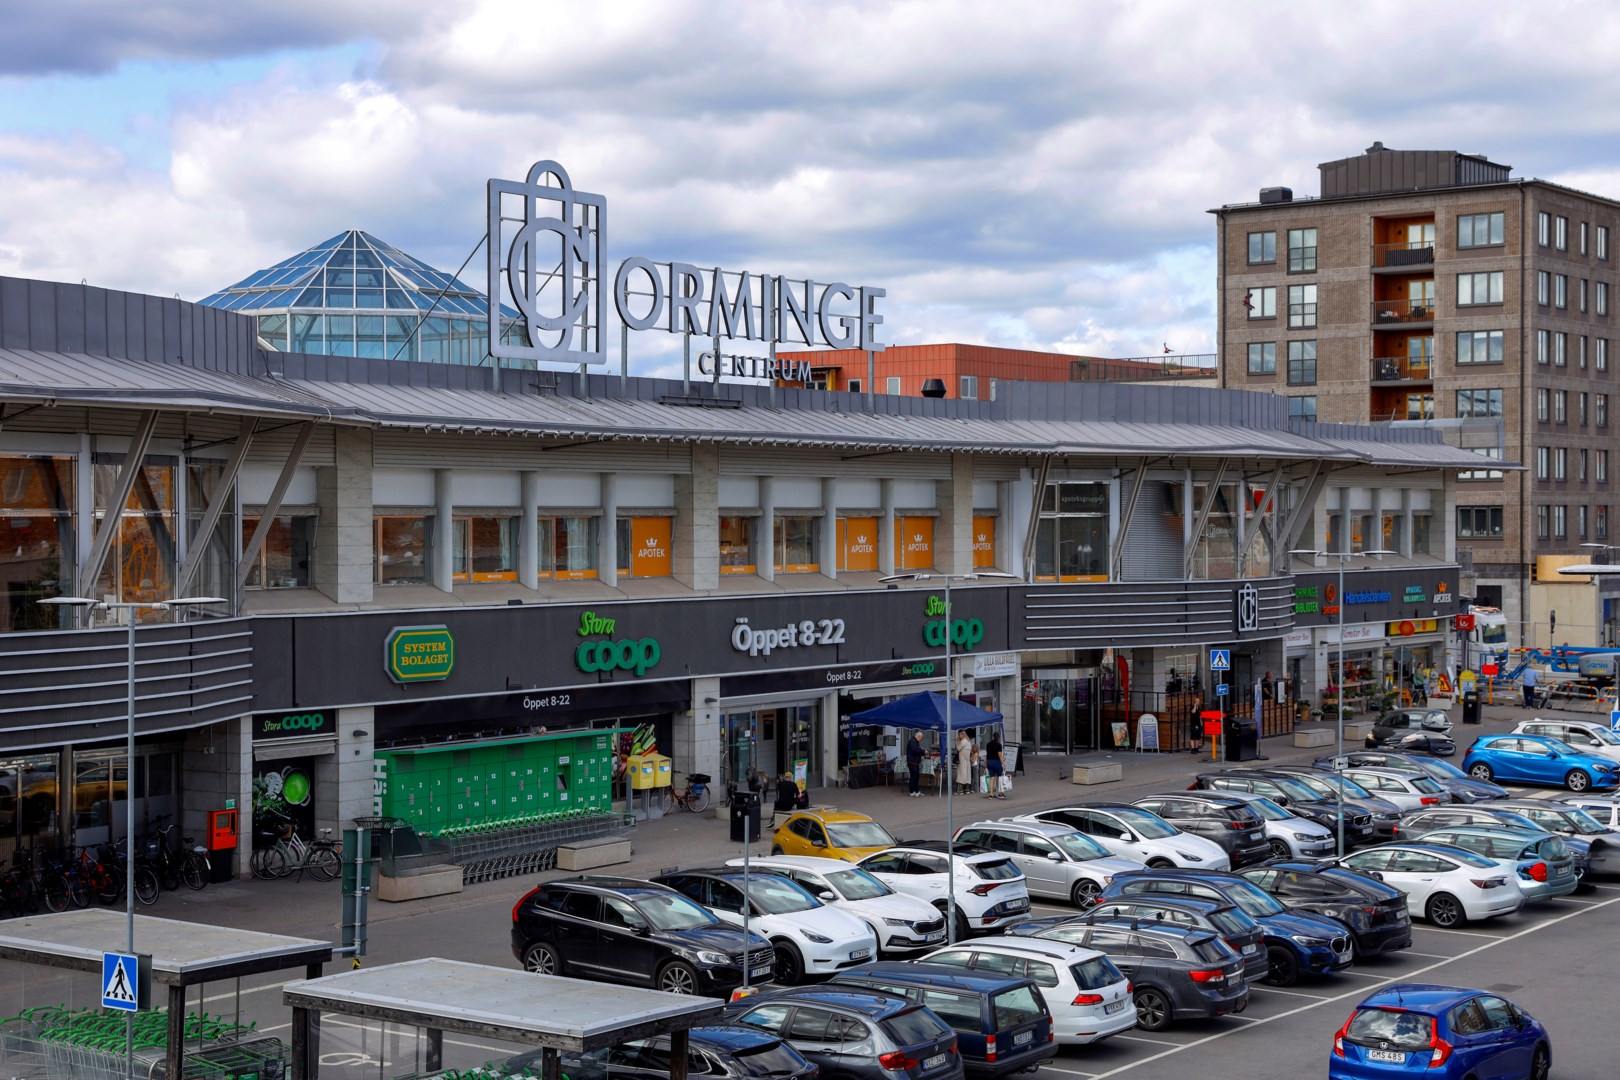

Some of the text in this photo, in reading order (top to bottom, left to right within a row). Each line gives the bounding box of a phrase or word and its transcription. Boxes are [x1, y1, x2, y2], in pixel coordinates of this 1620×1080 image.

[614, 256, 886, 352] ORMINGE
[698, 352, 812, 382] CENTRUM
[638, 548, 665, 558] APOTEK
[852, 544, 873, 552] APOTEK
[1344, 589, 1392, 604] Handelsbanken
[1433, 593, 1452, 604] APOTEK
[1295, 602, 1318, 613] BIBLIOTEK
[578, 611, 616, 636] Stora
[732, 618, 846, 656] Öppet 8-22
[923, 618, 984, 650] coop
[404, 642, 446, 653] SYSTEM
[401, 654, 448, 666] BOLAGET
[576, 638, 661, 676] coop
[826, 670, 862, 682] Öppet 8-22
[912, 662, 934, 676] coop
[523, 694, 570, 710] Öppet 8-22
[263, 714, 324, 732] Stora coop
[1371, 1050, 1385, 1059] GMS
